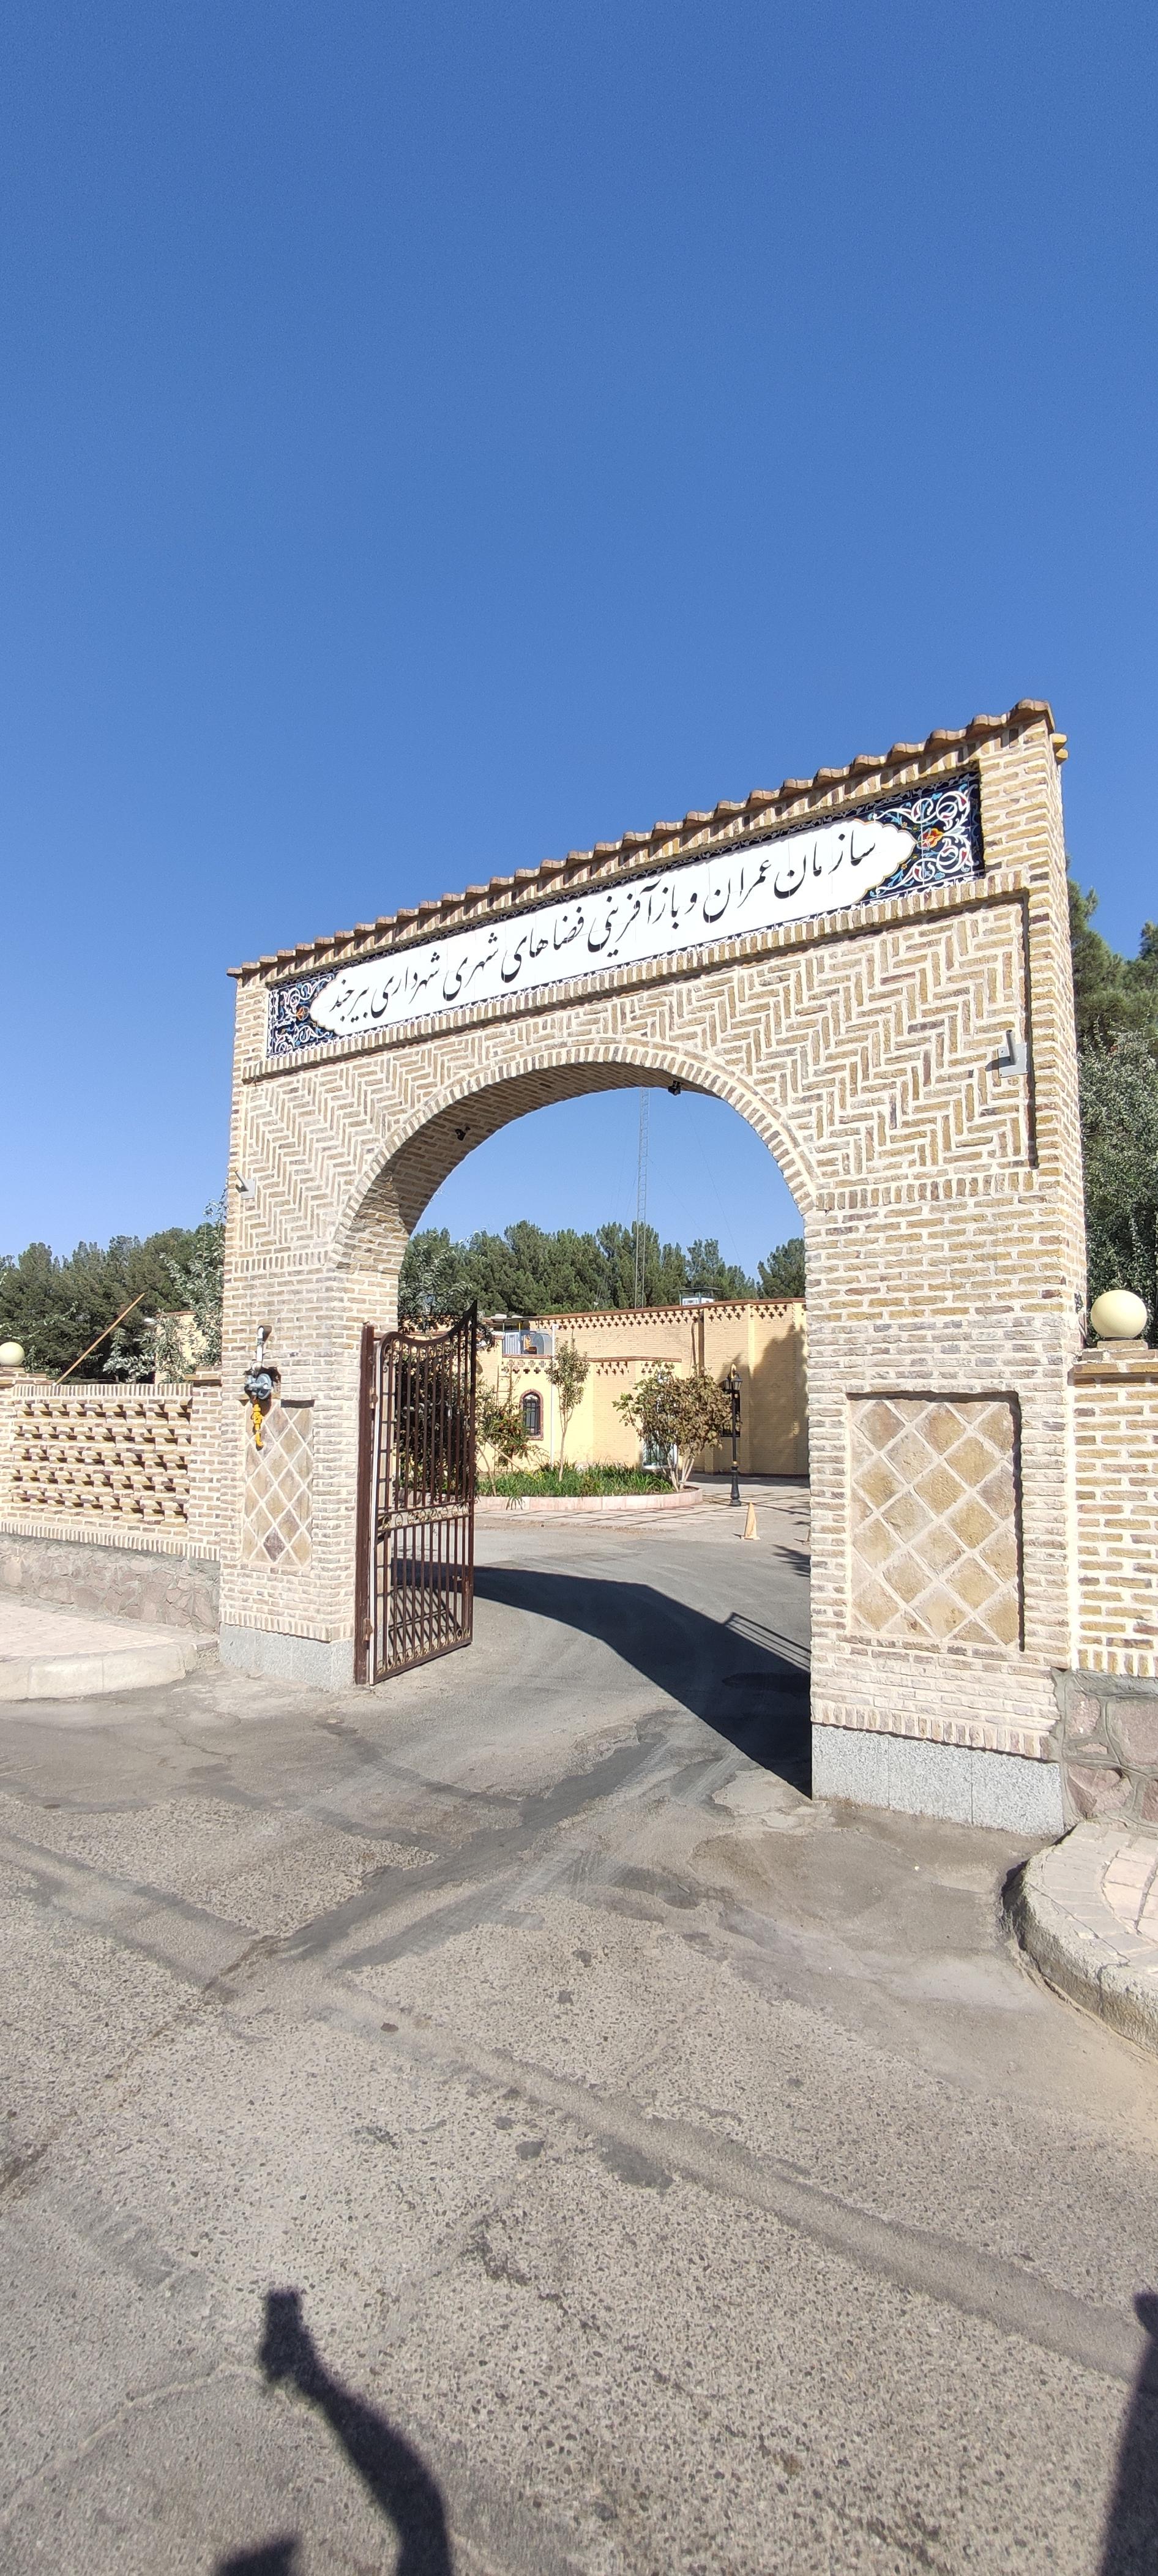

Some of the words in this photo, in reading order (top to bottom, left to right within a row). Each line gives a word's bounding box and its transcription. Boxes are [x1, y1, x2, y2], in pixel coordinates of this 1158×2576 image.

[702, 858, 771, 923] عمران
[774, 829, 876, 899] سازمان
[684, 892, 698, 915] و
[370, 951, 441, 1019] شهرداری
[443, 932, 498, 1002] شهری
[329, 978, 370, 1023] بیرجند
